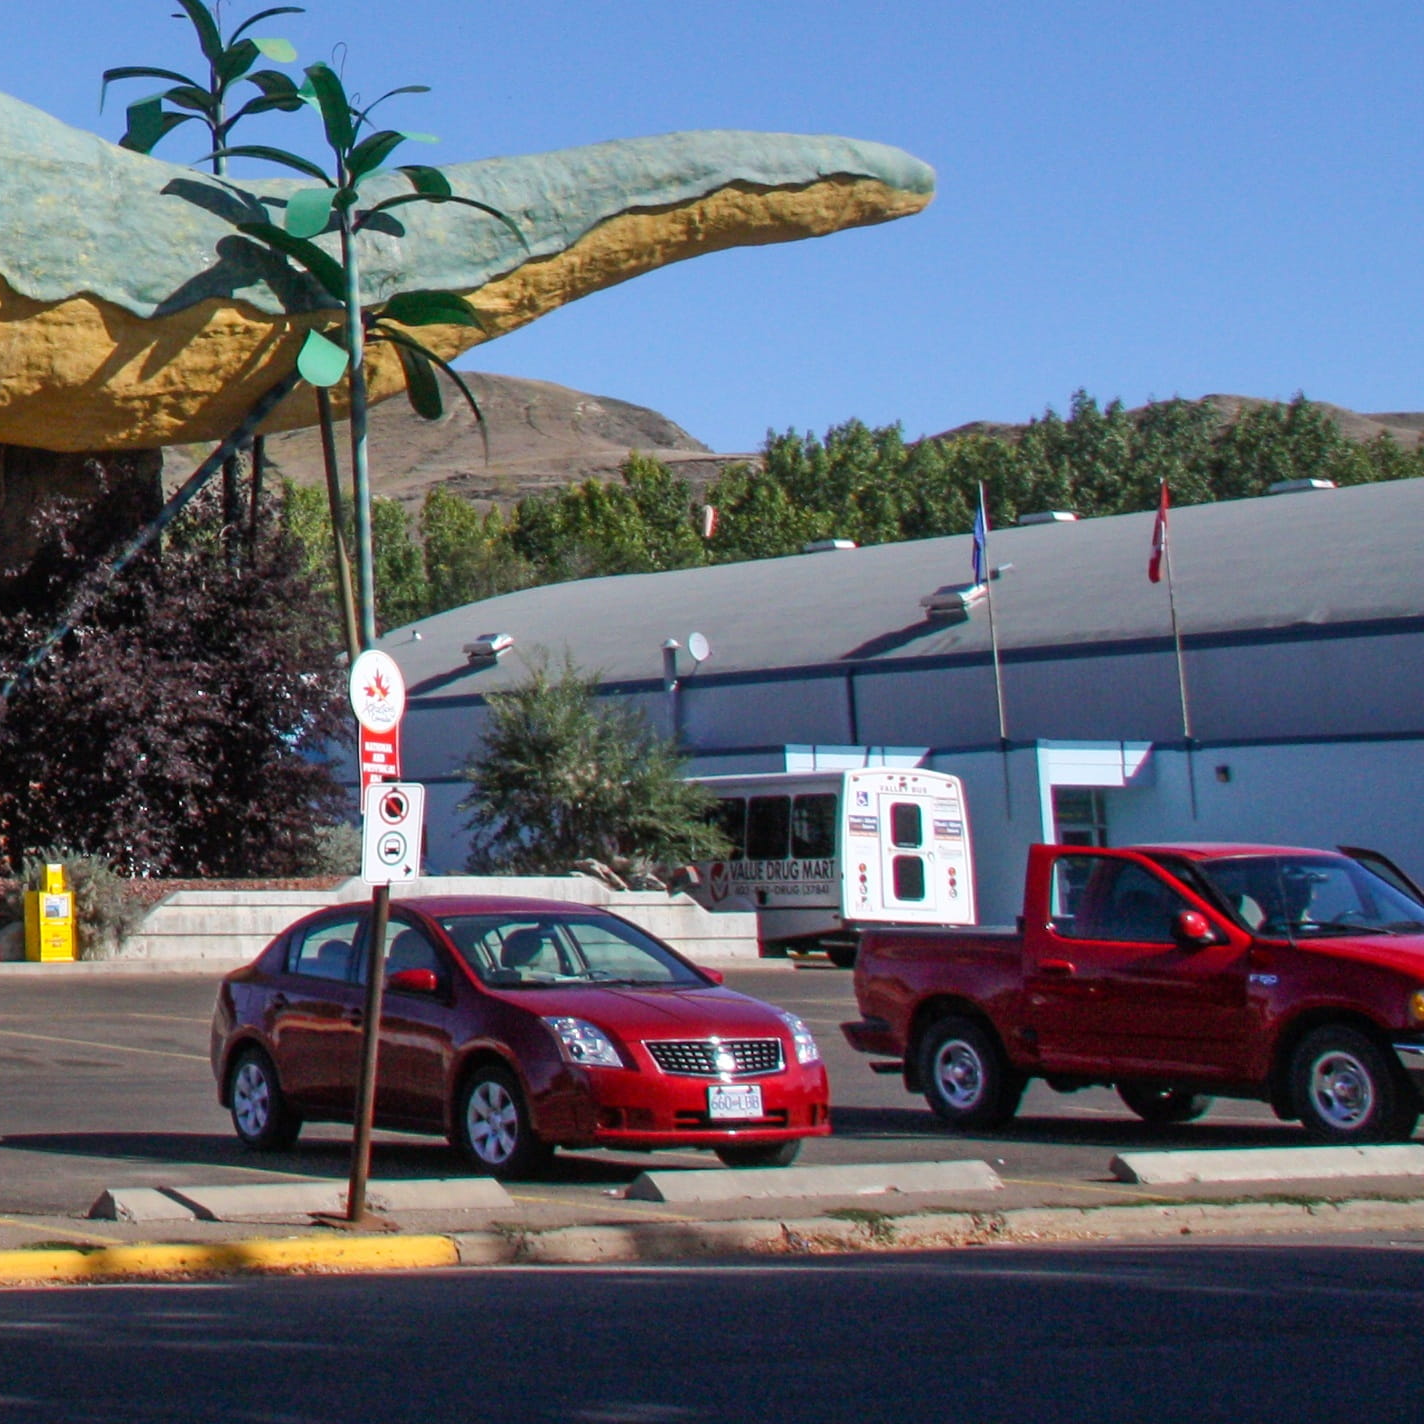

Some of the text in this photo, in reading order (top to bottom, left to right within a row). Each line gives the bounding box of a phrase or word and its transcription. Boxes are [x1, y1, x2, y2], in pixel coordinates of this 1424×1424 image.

[730, 859, 835, 880] VALUE DRUG MART
